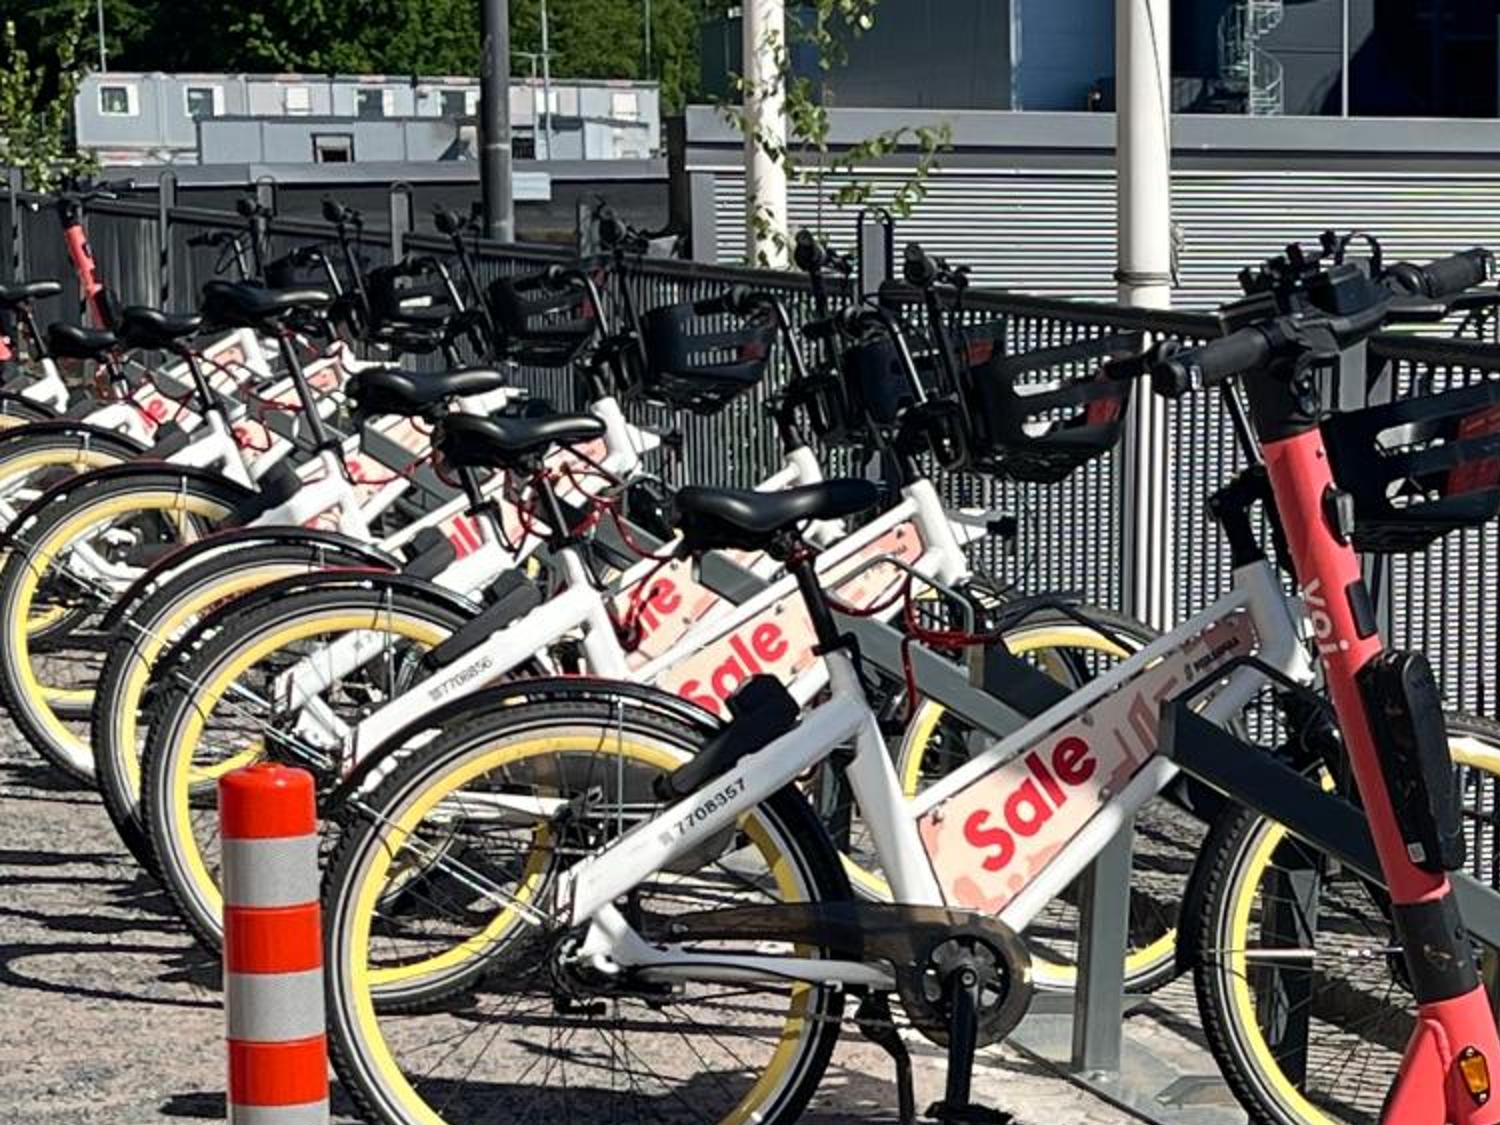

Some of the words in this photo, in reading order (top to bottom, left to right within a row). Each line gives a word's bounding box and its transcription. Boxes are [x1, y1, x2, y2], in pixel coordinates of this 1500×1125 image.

[1303, 577, 1350, 670] voi.
[674, 777, 745, 835] 7708357
[963, 736, 1097, 872] Sale
